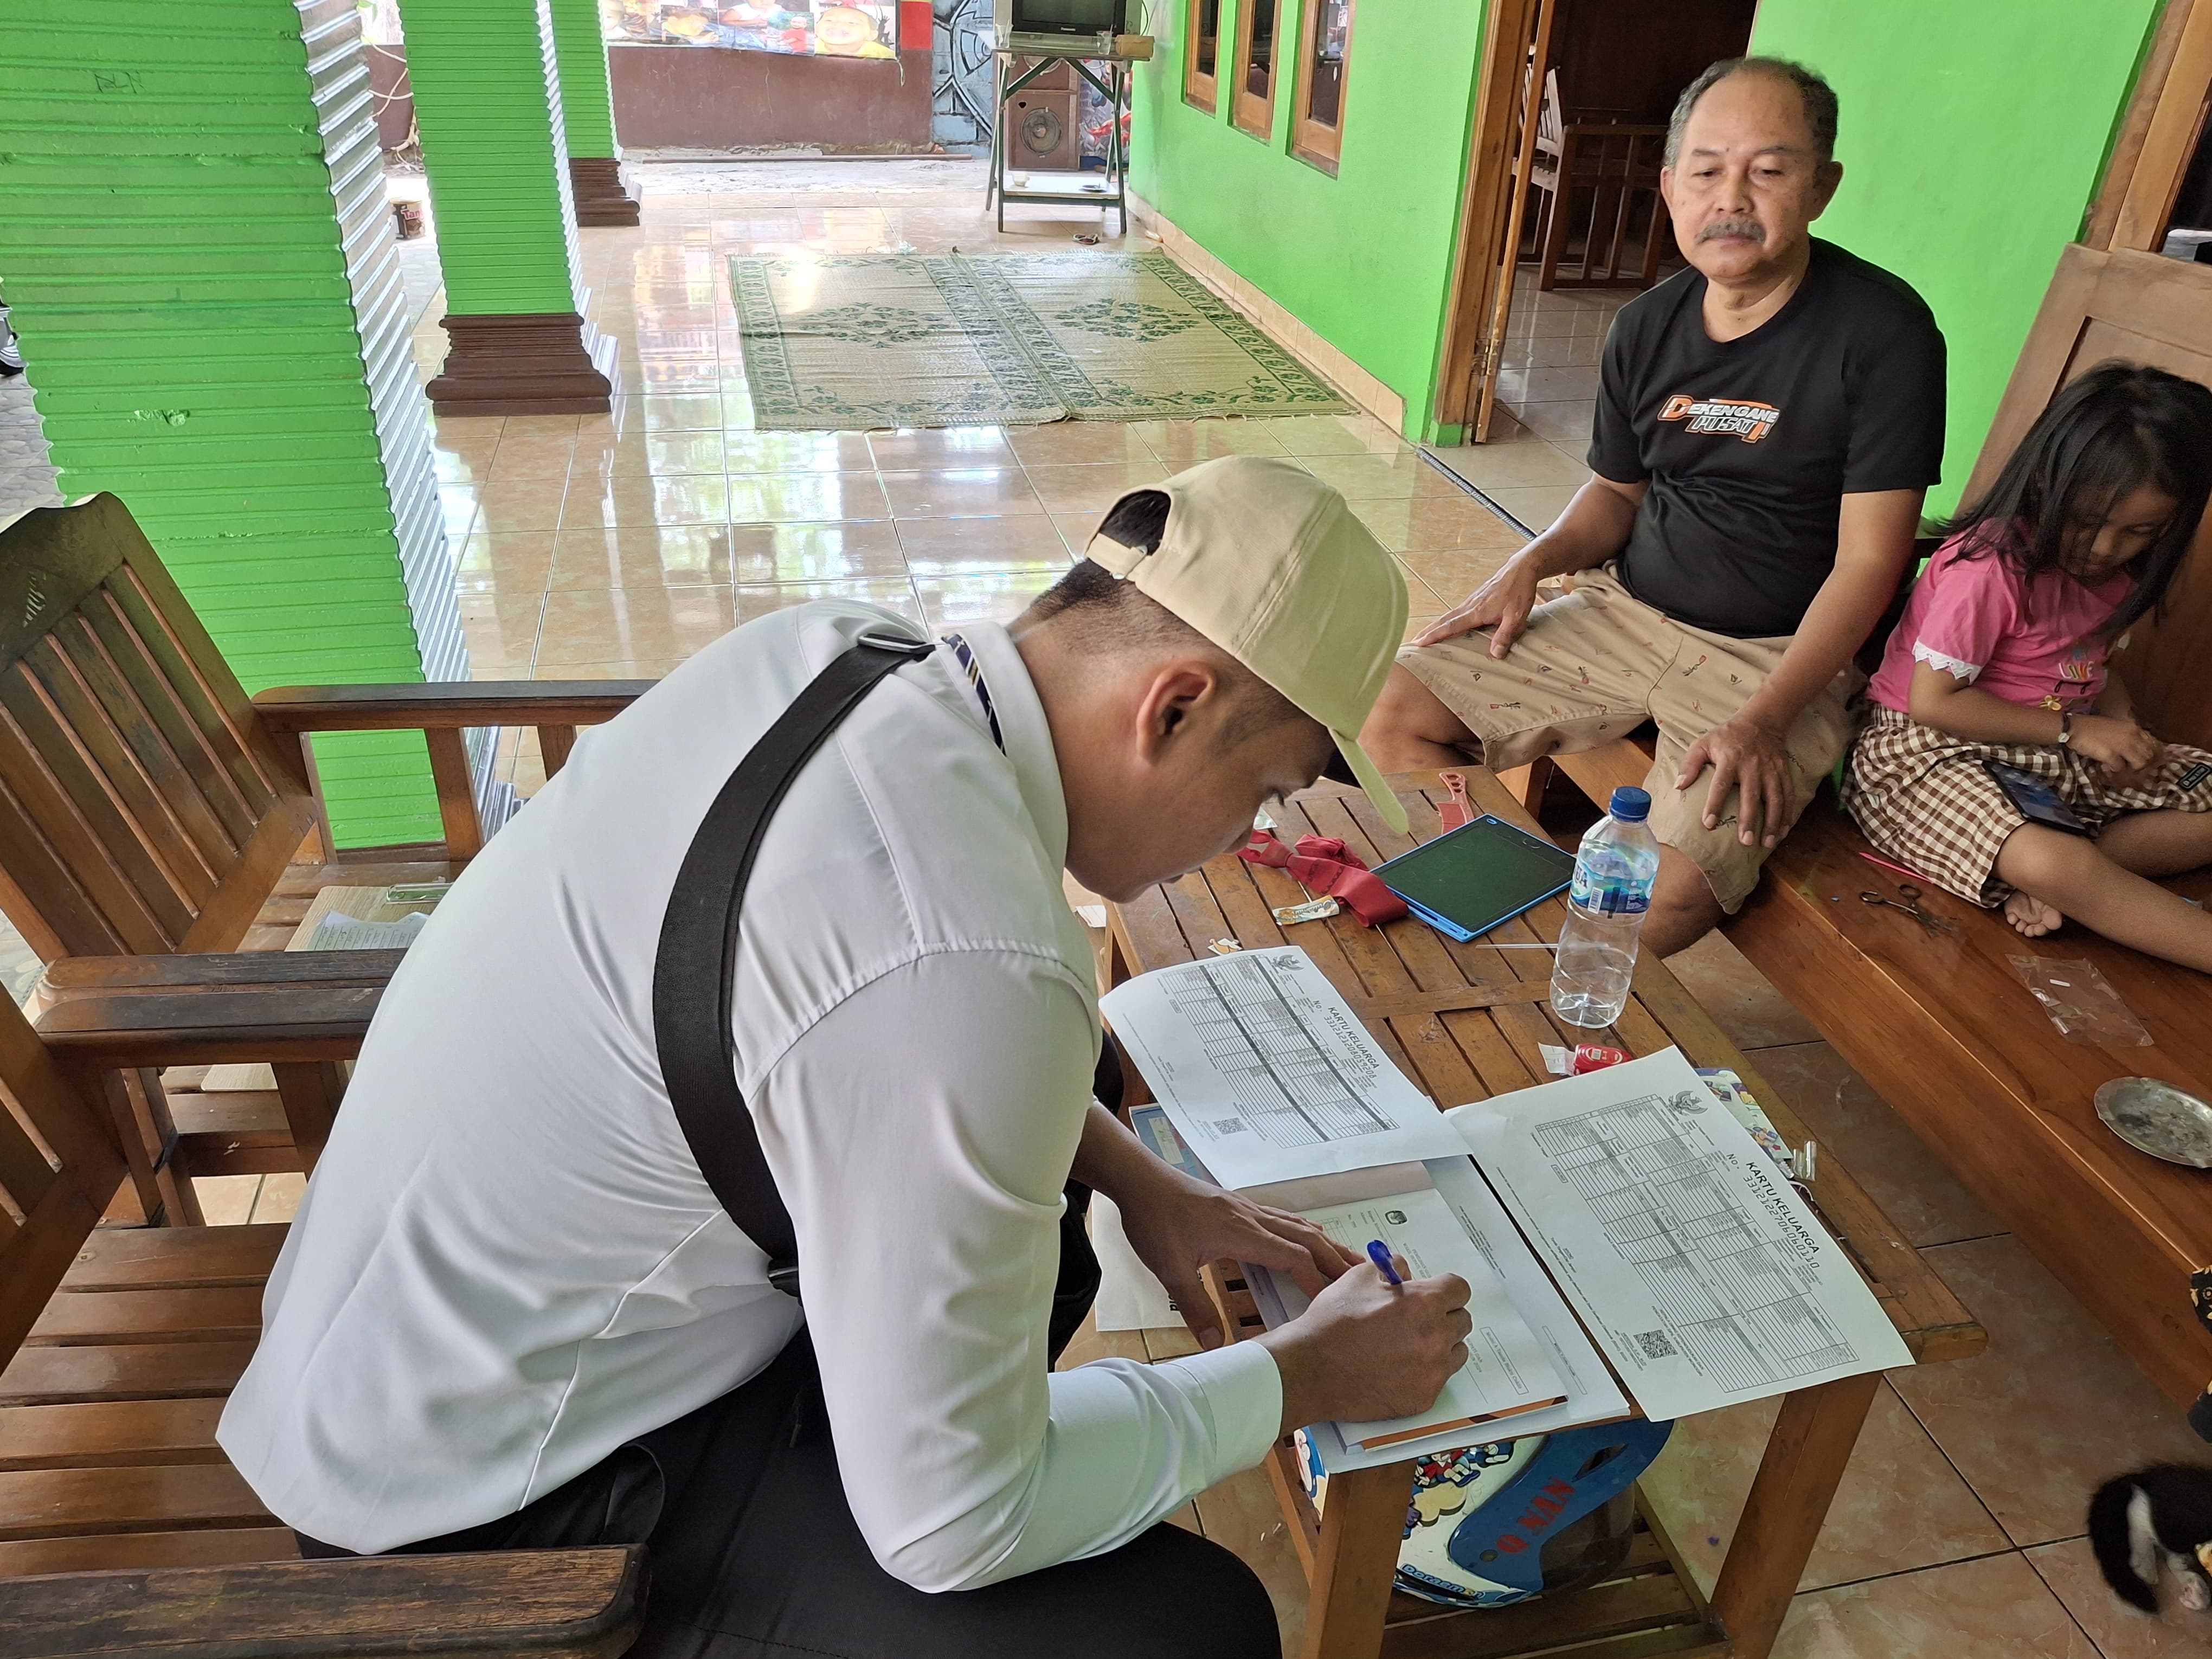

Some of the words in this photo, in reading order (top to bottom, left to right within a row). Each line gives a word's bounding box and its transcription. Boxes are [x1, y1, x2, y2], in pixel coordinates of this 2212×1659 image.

[1662, 397, 1779, 423] DEKENGANE
[1327, 1006, 1351, 1030] KARTU
[1347, 1030, 1380, 1068] KELUARGA
[1745, 1162, 1777, 1196] KARTU
[1772, 1197, 1820, 1253] KELUARGA
[1401, 1564, 1486, 1598] Doraemon
